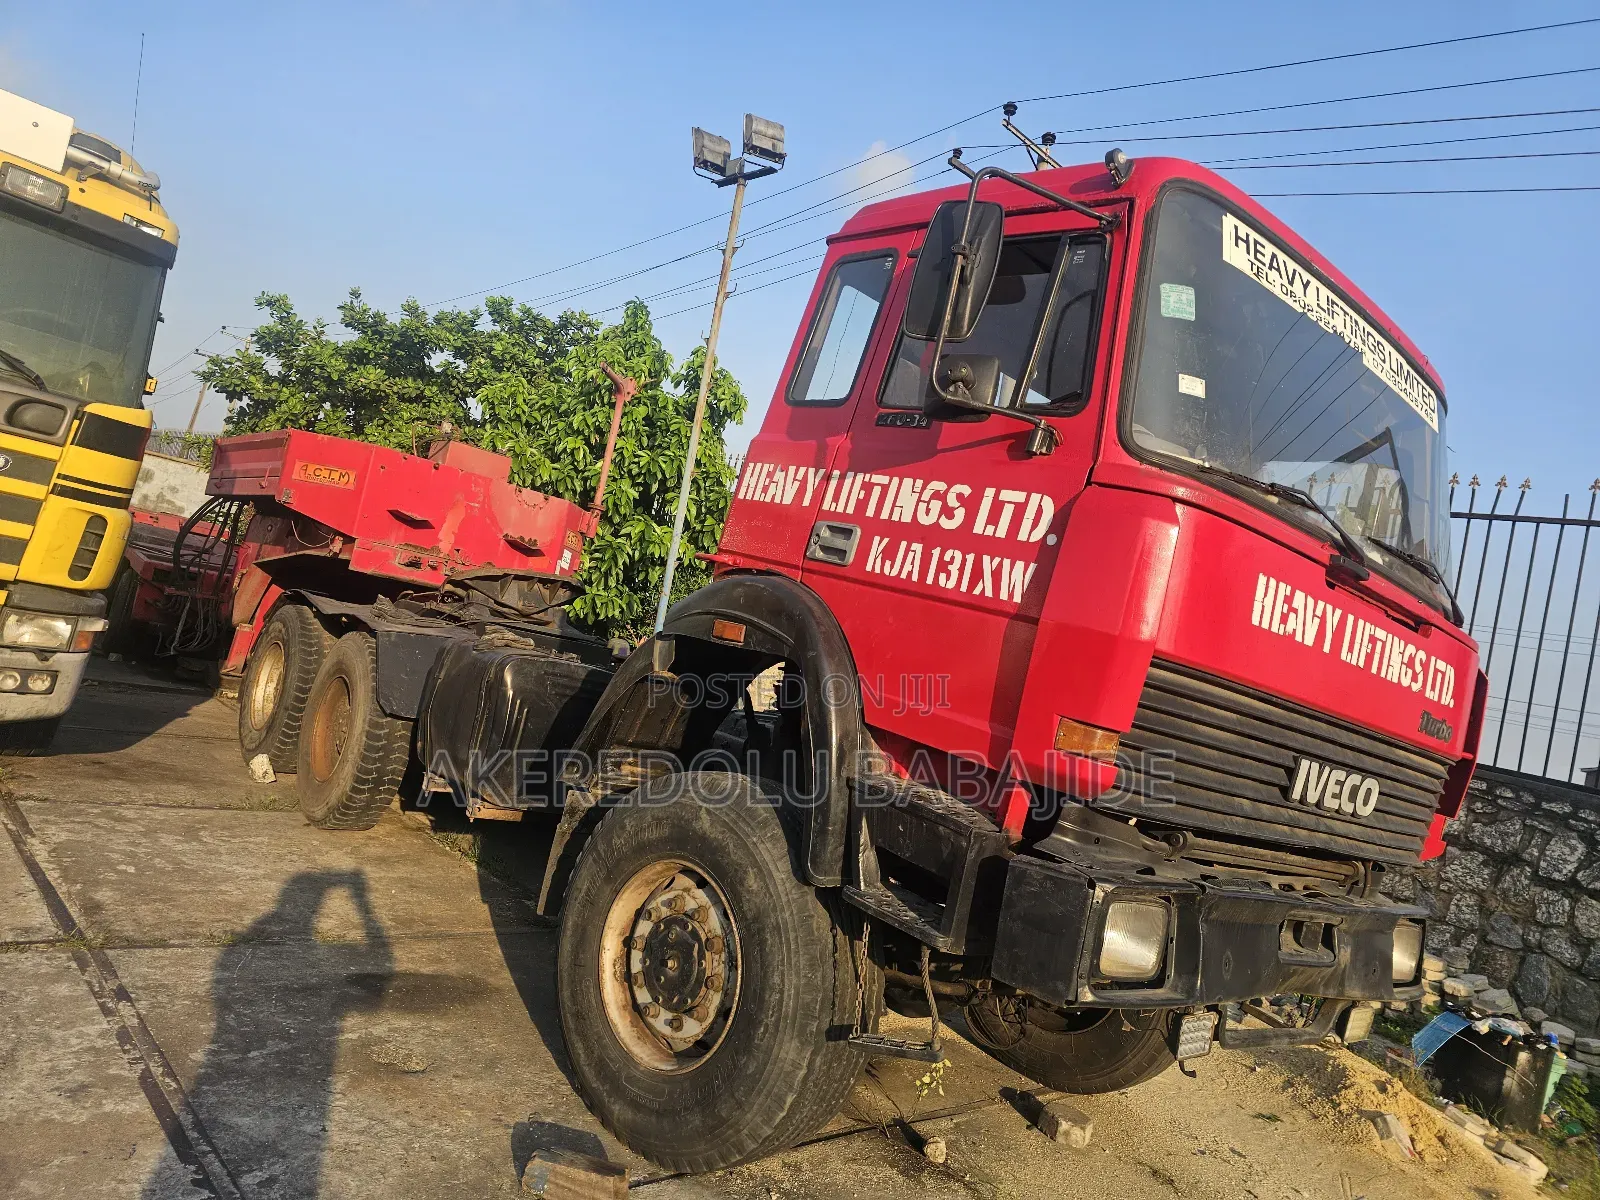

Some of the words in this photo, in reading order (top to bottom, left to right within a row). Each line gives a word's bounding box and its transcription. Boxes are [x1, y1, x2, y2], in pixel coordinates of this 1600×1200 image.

[1247, 258, 1276, 288] TEL:
[1233, 223, 1312, 298] HEAVY
[1315, 286, 1386, 365] LIFTINGS
[1388, 350, 1437, 415] LIMITED
[737, 462, 826, 507] HEAVY
[822, 468, 972, 530] LIFTINGS
[973, 487, 1057, 546] LTD.
[1251, 572, 1343, 654] HEAVY
[1340, 613, 1427, 693] LIFTINGS
[1424, 655, 1455, 708] LTD.
[1418, 709, 1453, 744] Turbo
[1291, 757, 1380, 818] IVECO
